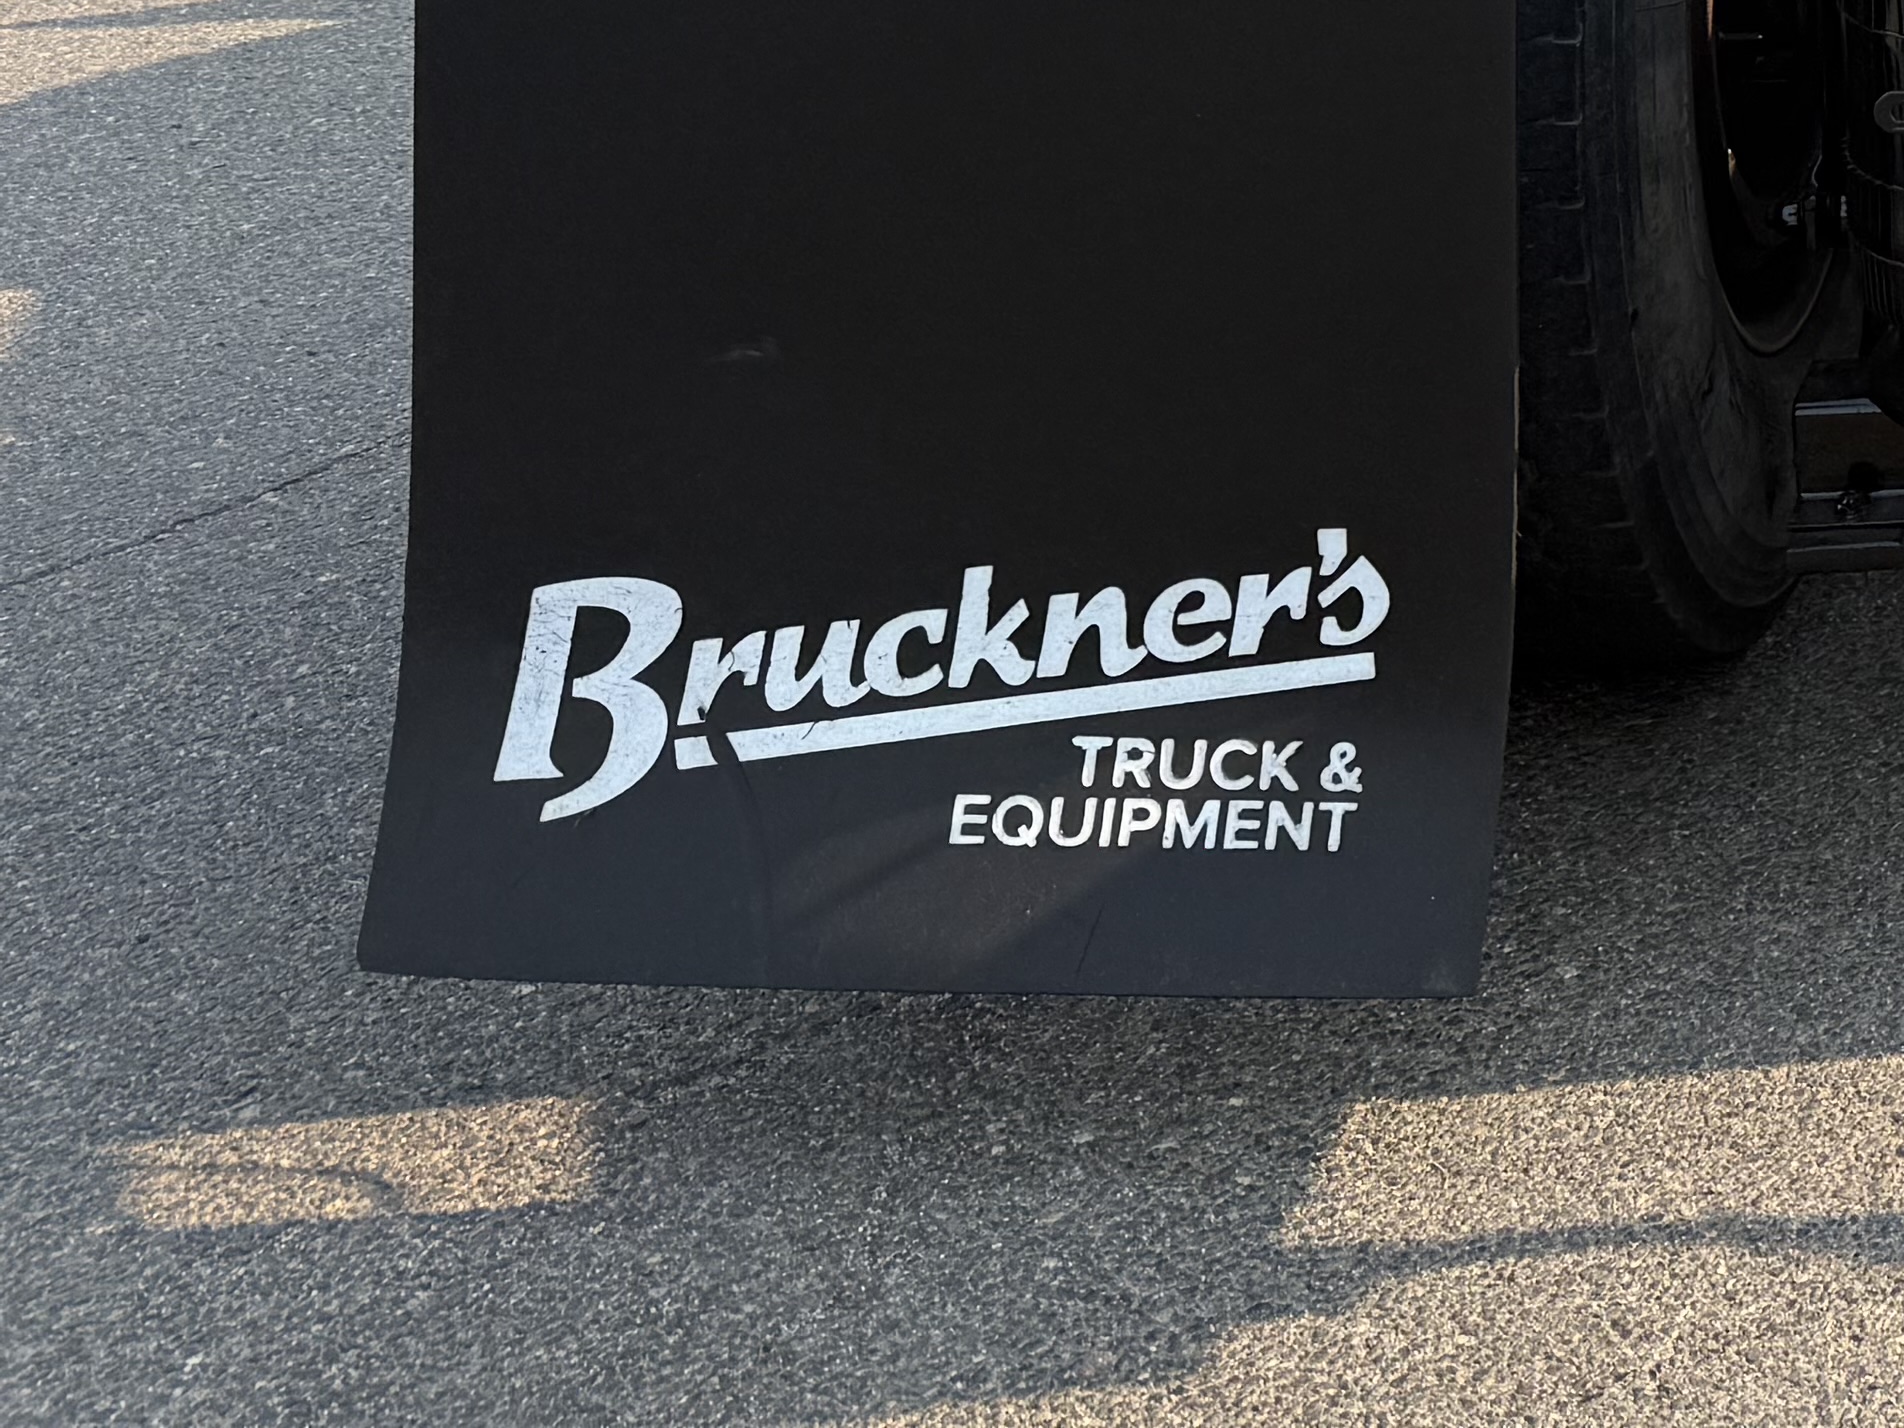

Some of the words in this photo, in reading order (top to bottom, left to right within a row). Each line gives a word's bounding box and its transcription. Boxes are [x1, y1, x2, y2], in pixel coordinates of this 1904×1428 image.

[494, 528, 1390, 822] Bruckner's
[1072, 735, 1303, 792] TRUCK
[1320, 741, 1363, 793] &
[949, 793, 1358, 852] EQUIPMENT
